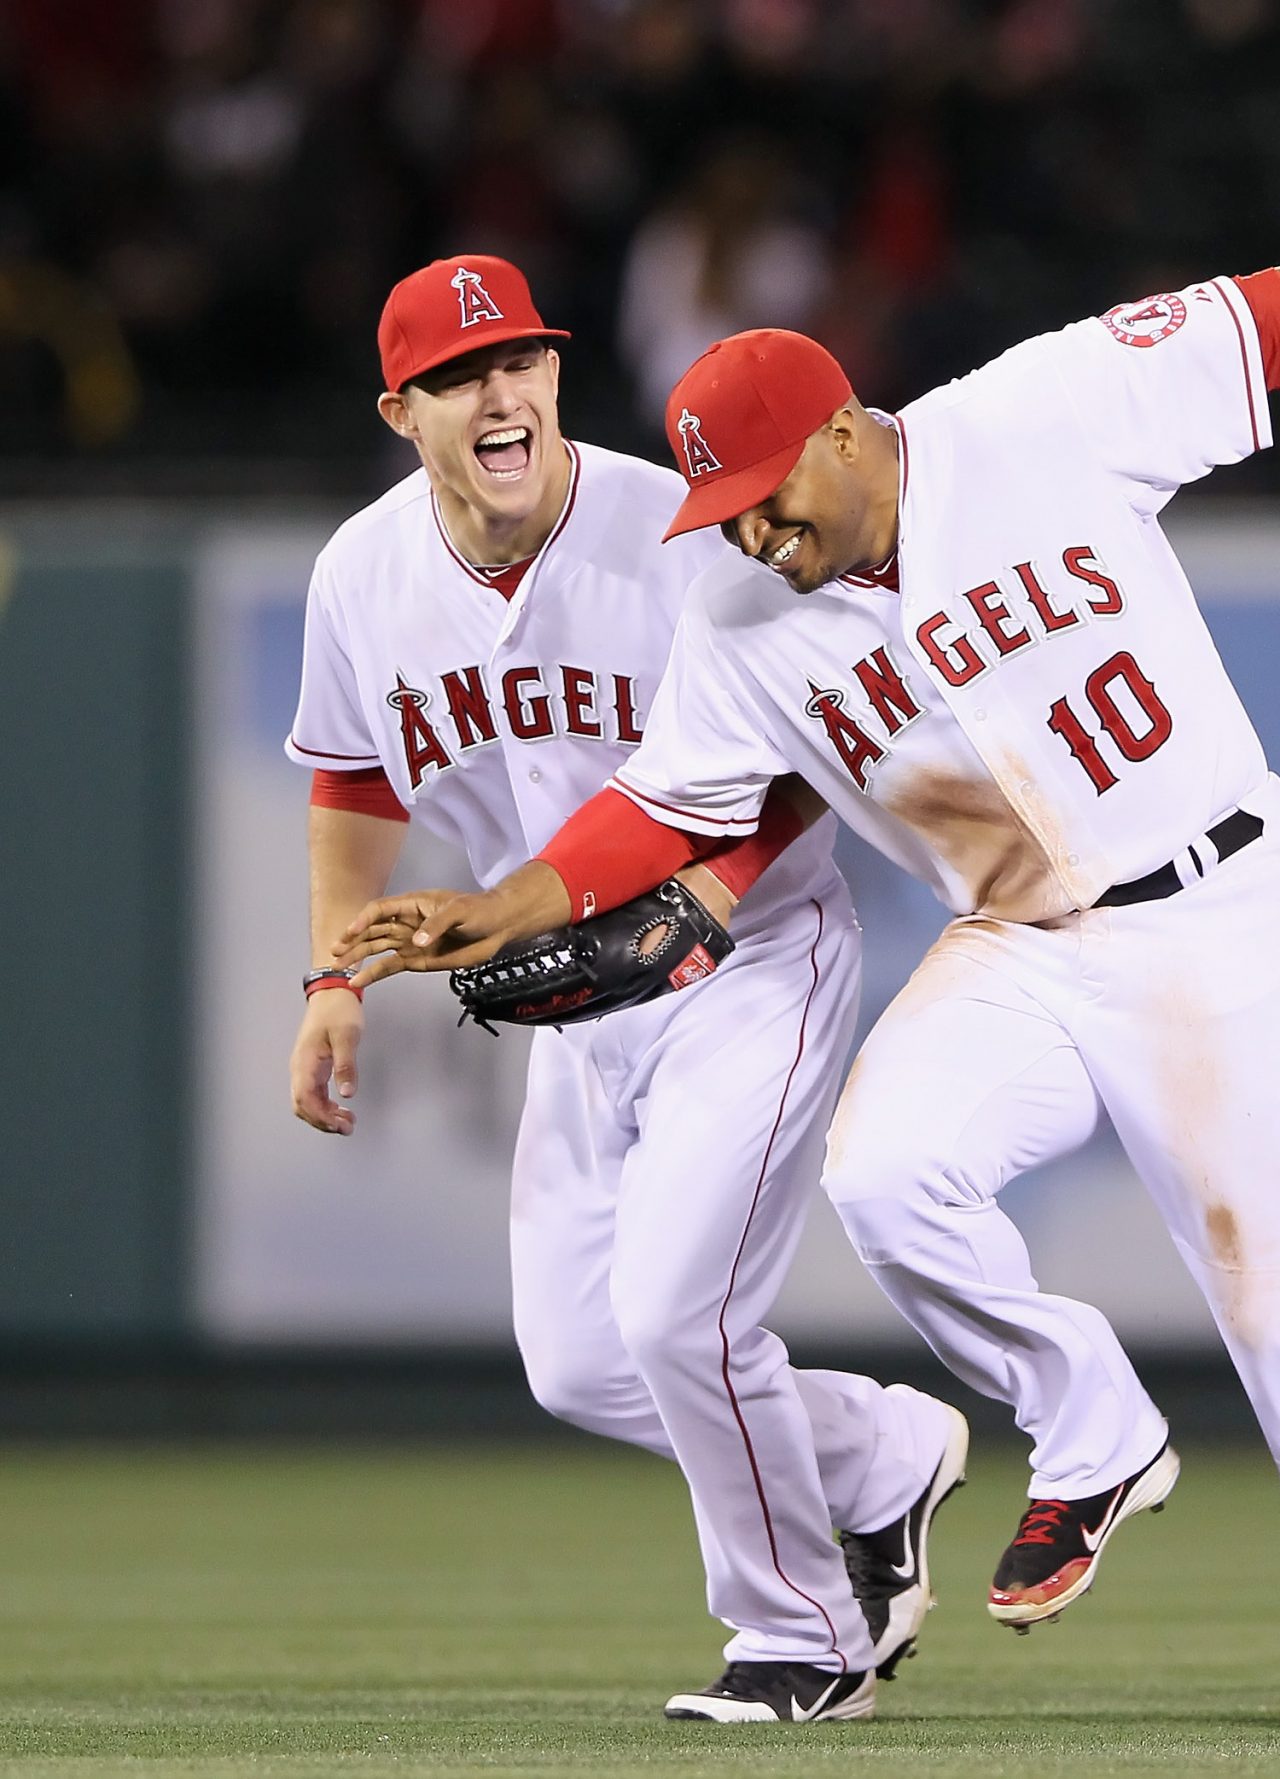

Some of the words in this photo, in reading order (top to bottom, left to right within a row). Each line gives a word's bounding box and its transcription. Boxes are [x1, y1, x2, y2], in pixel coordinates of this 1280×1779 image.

[450, 266, 504, 329] A
[678, 407, 723, 478] A
[387, 665, 644, 793] ANGEL
[802, 545, 1127, 795] ANGELS
[1045, 650, 1173, 798] 10
